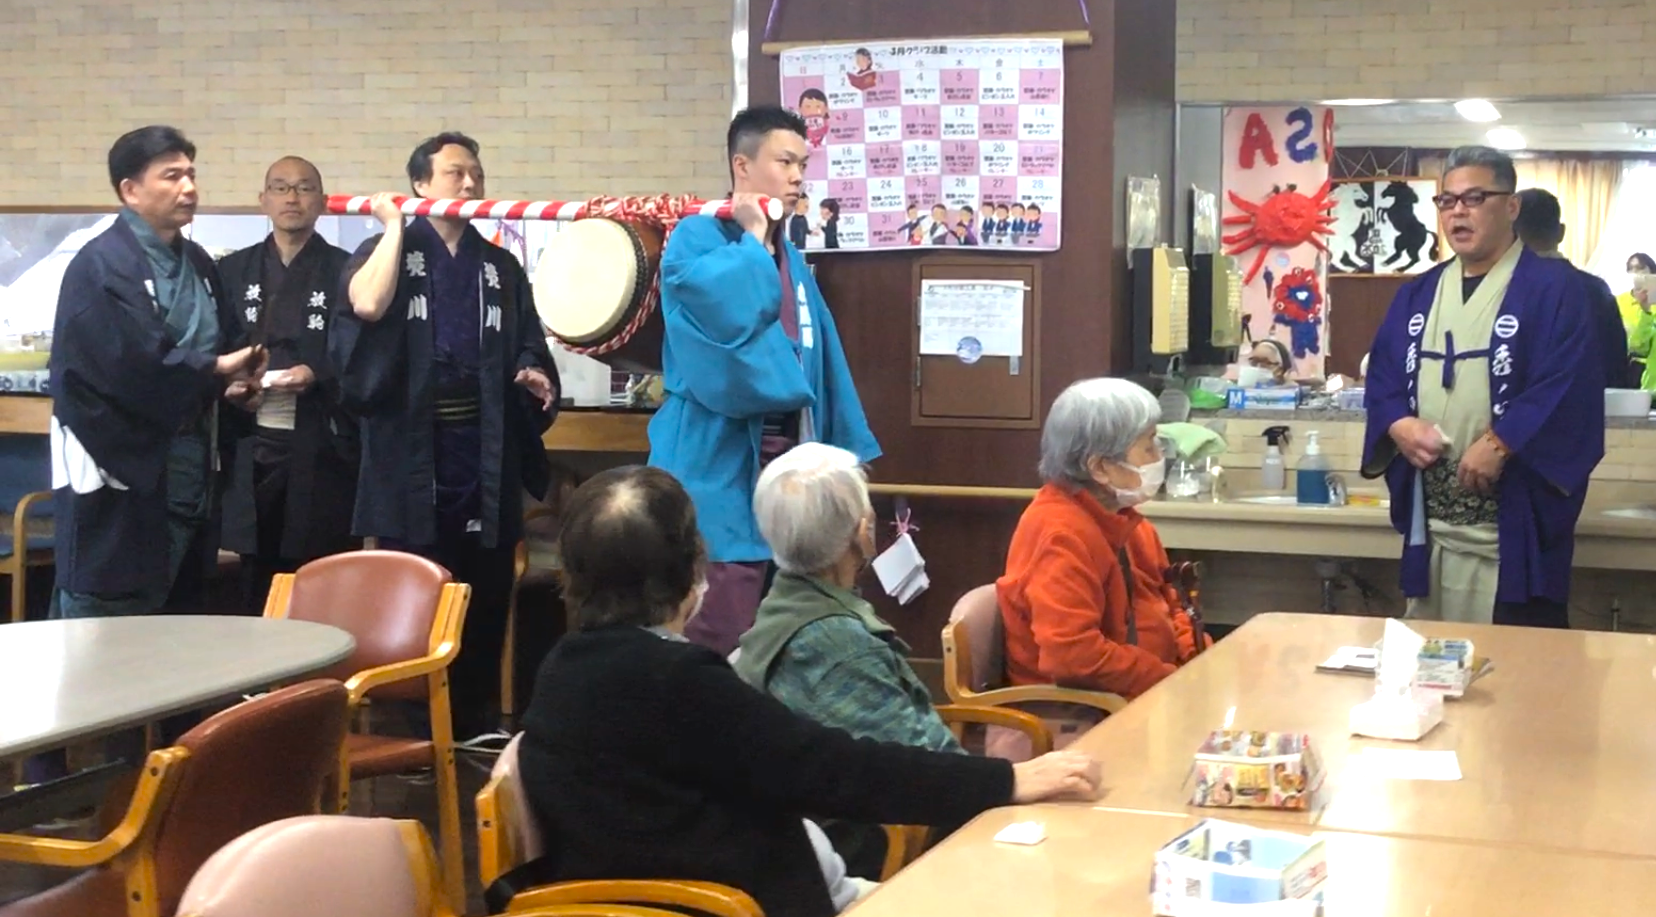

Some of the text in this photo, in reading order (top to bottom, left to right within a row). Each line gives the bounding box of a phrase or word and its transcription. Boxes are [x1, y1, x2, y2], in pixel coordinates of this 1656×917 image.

[916, 72, 924, 82] 4
[956, 71, 963, 82] 5
[995, 72, 1003, 81] 6
[1038, 71, 1044, 81] 7
[842, 107, 1045, 121] 9 10 11 12 13 14
[841, 146, 853, 156] 16
[954, 142, 966, 152] 19
[993, 142, 1006, 153] 20
[841, 181, 854, 192] 23
[880, 179, 892, 189] 24
[955, 177, 967, 188] 26
[993, 178, 1004, 188] 27
[1031, 179, 1044, 189] 28
[844, 213, 892, 226] 30 31
[1229, 391, 1243, 405] M
